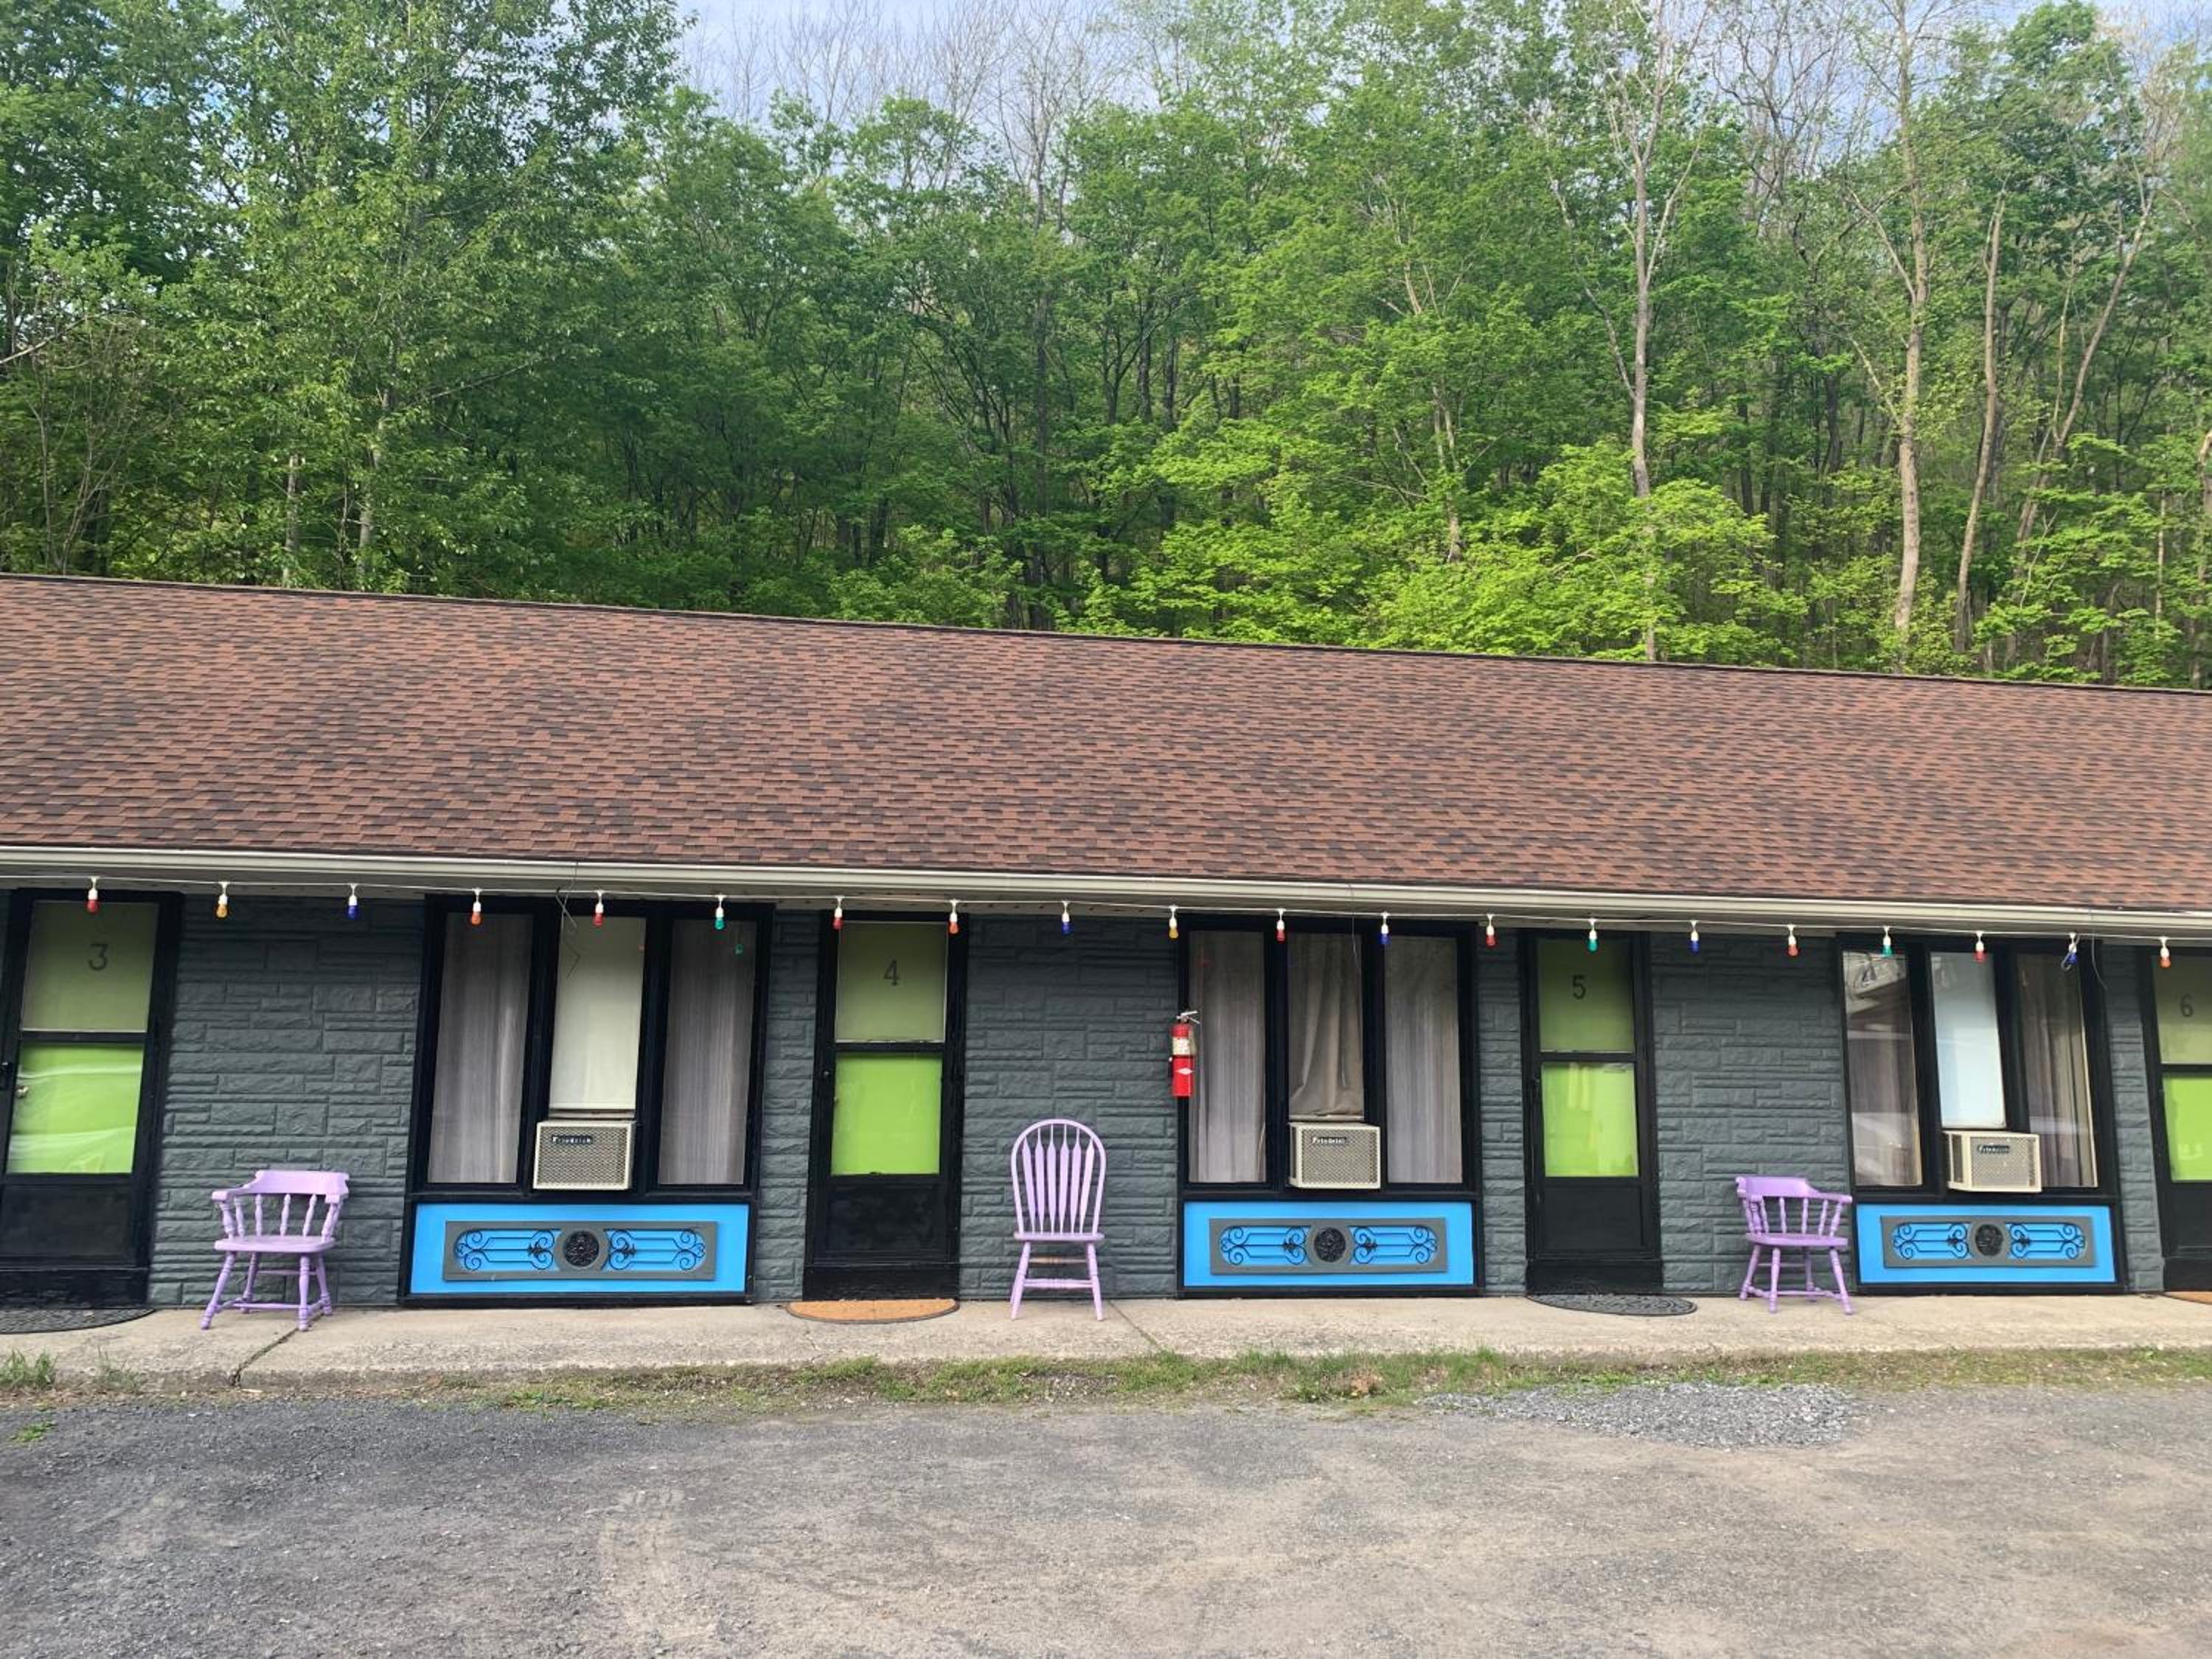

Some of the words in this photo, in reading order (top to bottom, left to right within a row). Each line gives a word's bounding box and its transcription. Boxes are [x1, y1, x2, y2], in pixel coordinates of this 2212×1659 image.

[88, 943, 108, 971] 3
[883, 959, 900, 986] 4
[1572, 974, 1587, 1000] 5
[2180, 993, 2194, 1018] 6
